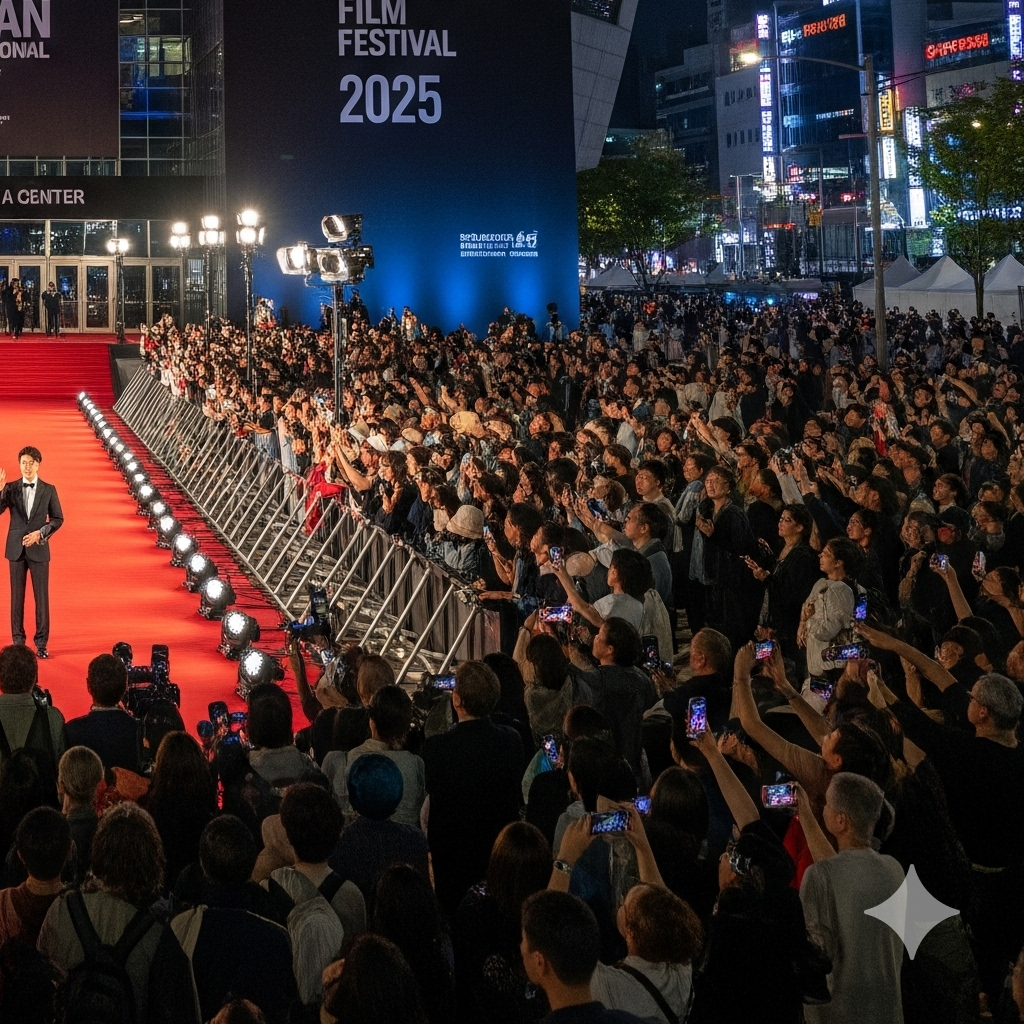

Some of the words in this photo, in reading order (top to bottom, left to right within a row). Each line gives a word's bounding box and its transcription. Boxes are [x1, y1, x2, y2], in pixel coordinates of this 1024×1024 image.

[338, 29, 457, 57] FESTIVAL
[339, 74, 443, 124] 2025
[17, 189, 85, 205] CENTER
